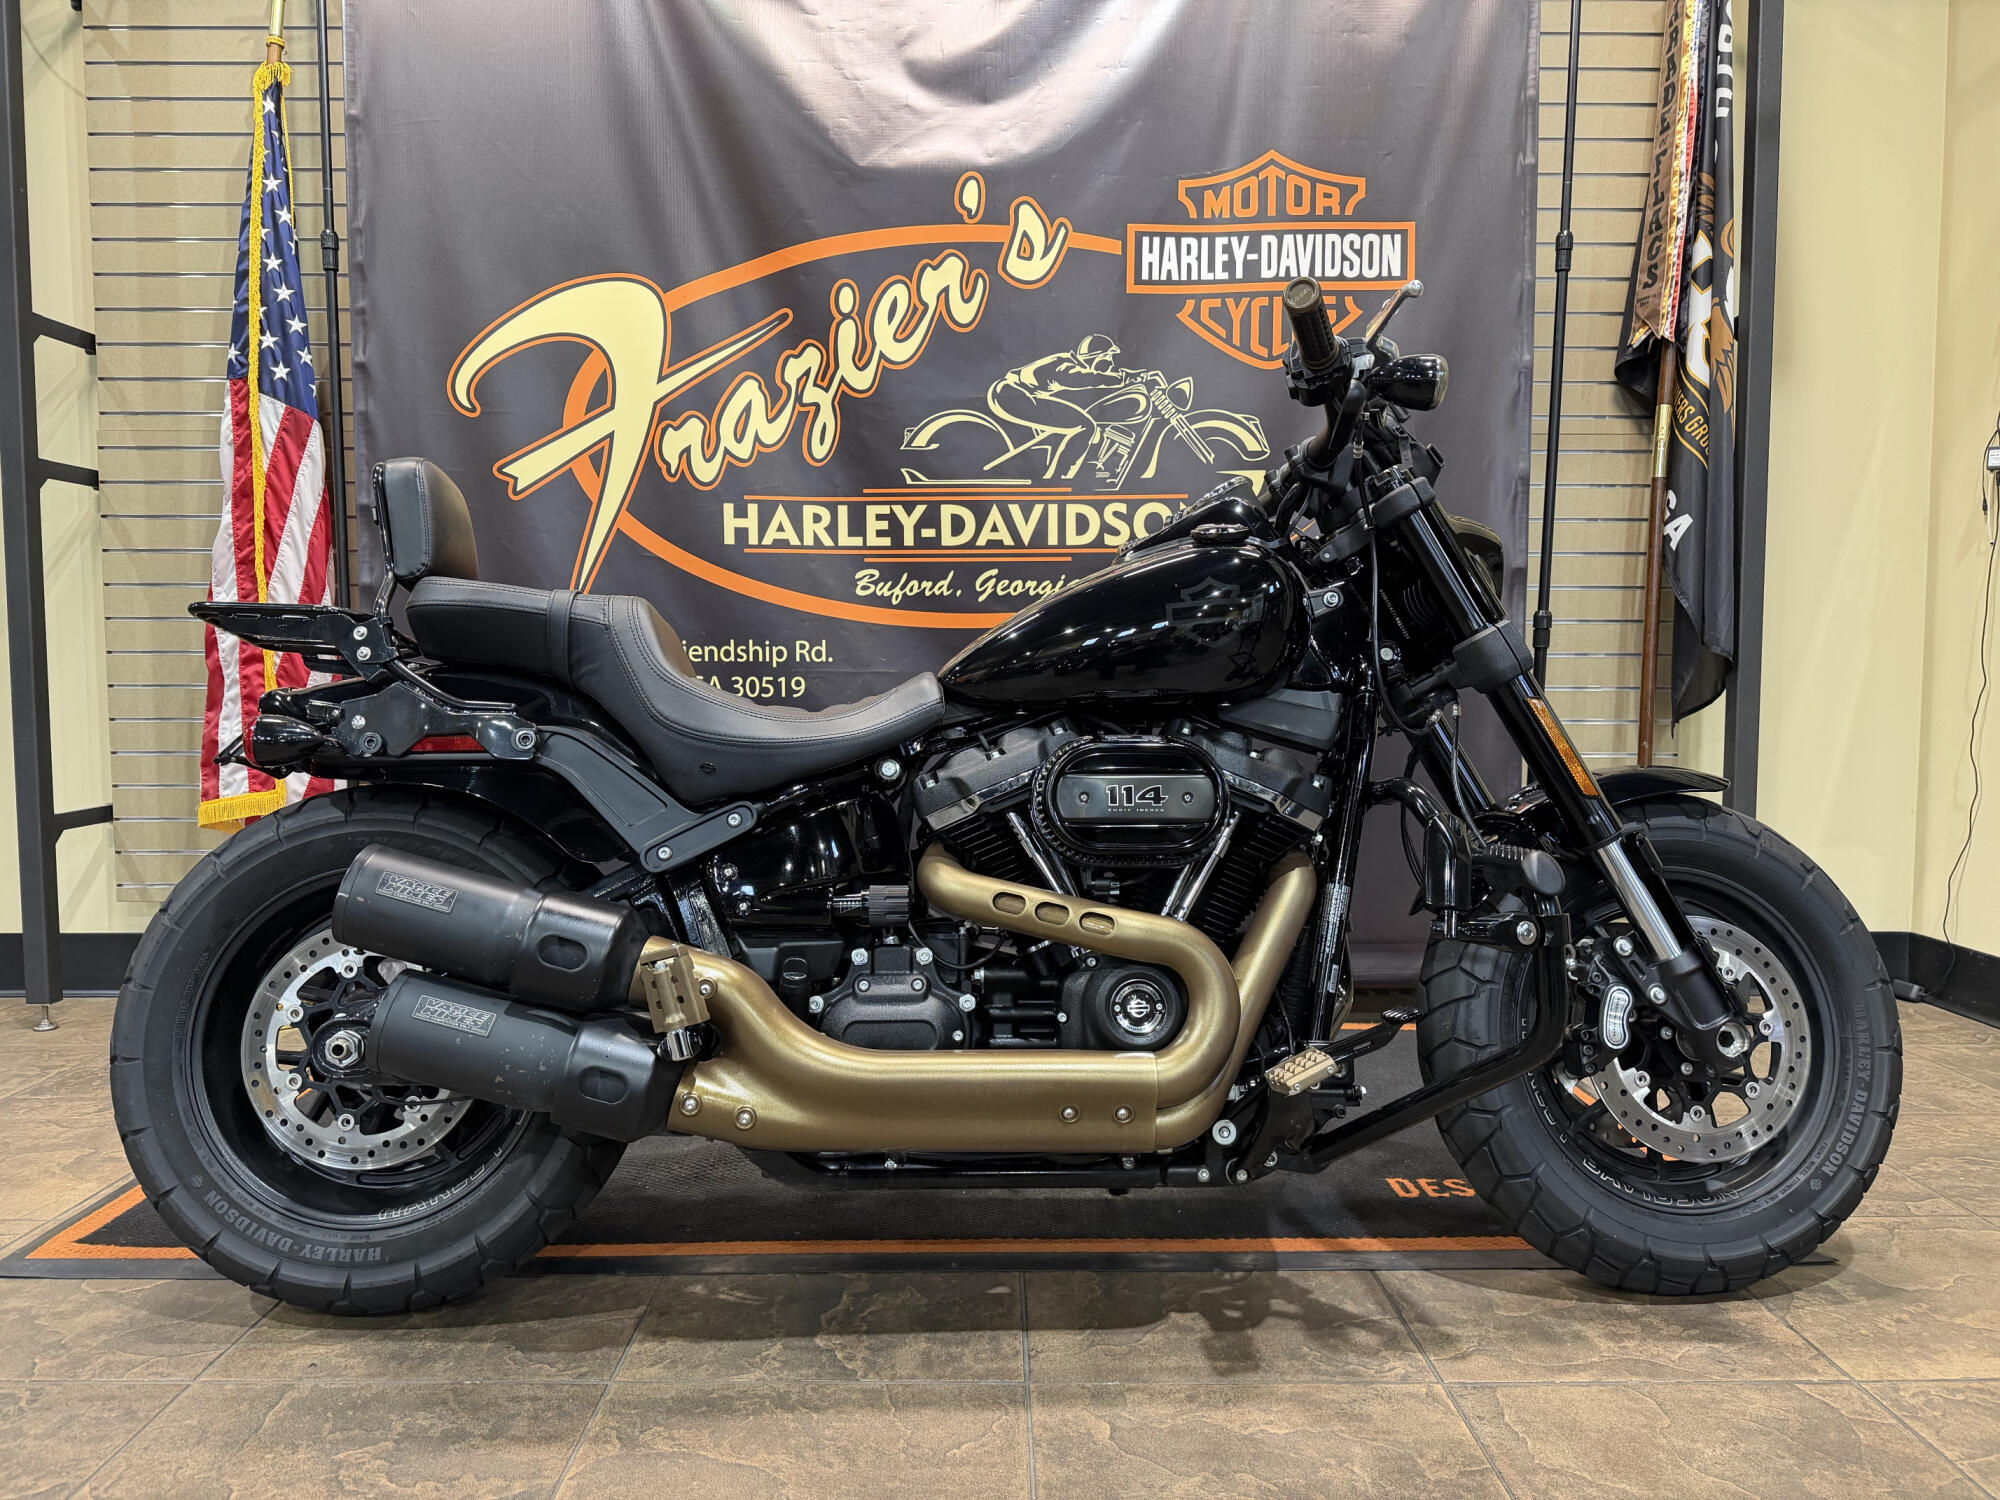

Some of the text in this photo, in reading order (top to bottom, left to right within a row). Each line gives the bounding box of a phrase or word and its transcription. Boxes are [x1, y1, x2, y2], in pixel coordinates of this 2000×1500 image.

[1660, 0, 1679, 135] ARADE
[1204, 166, 1341, 218] MOTOR
[1642, 148, 1668, 290] FLAGS
[1140, 233, 1402, 281] HARLEY-DAVIDSON
[1201, 296, 1337, 357] CYCL
[448, 173, 1071, 594] Frazier's
[723, 500, 1187, 547] HARLEY-DAVIDSO
[681, 639, 833, 667] iendship Rd.
[731, 676, 806, 698] 30519
[1106, 784, 1169, 806] 114
[1386, 1178, 1476, 1198] DES
[202, 1189, 382, 1263] HARLEY-DAVIDSON
